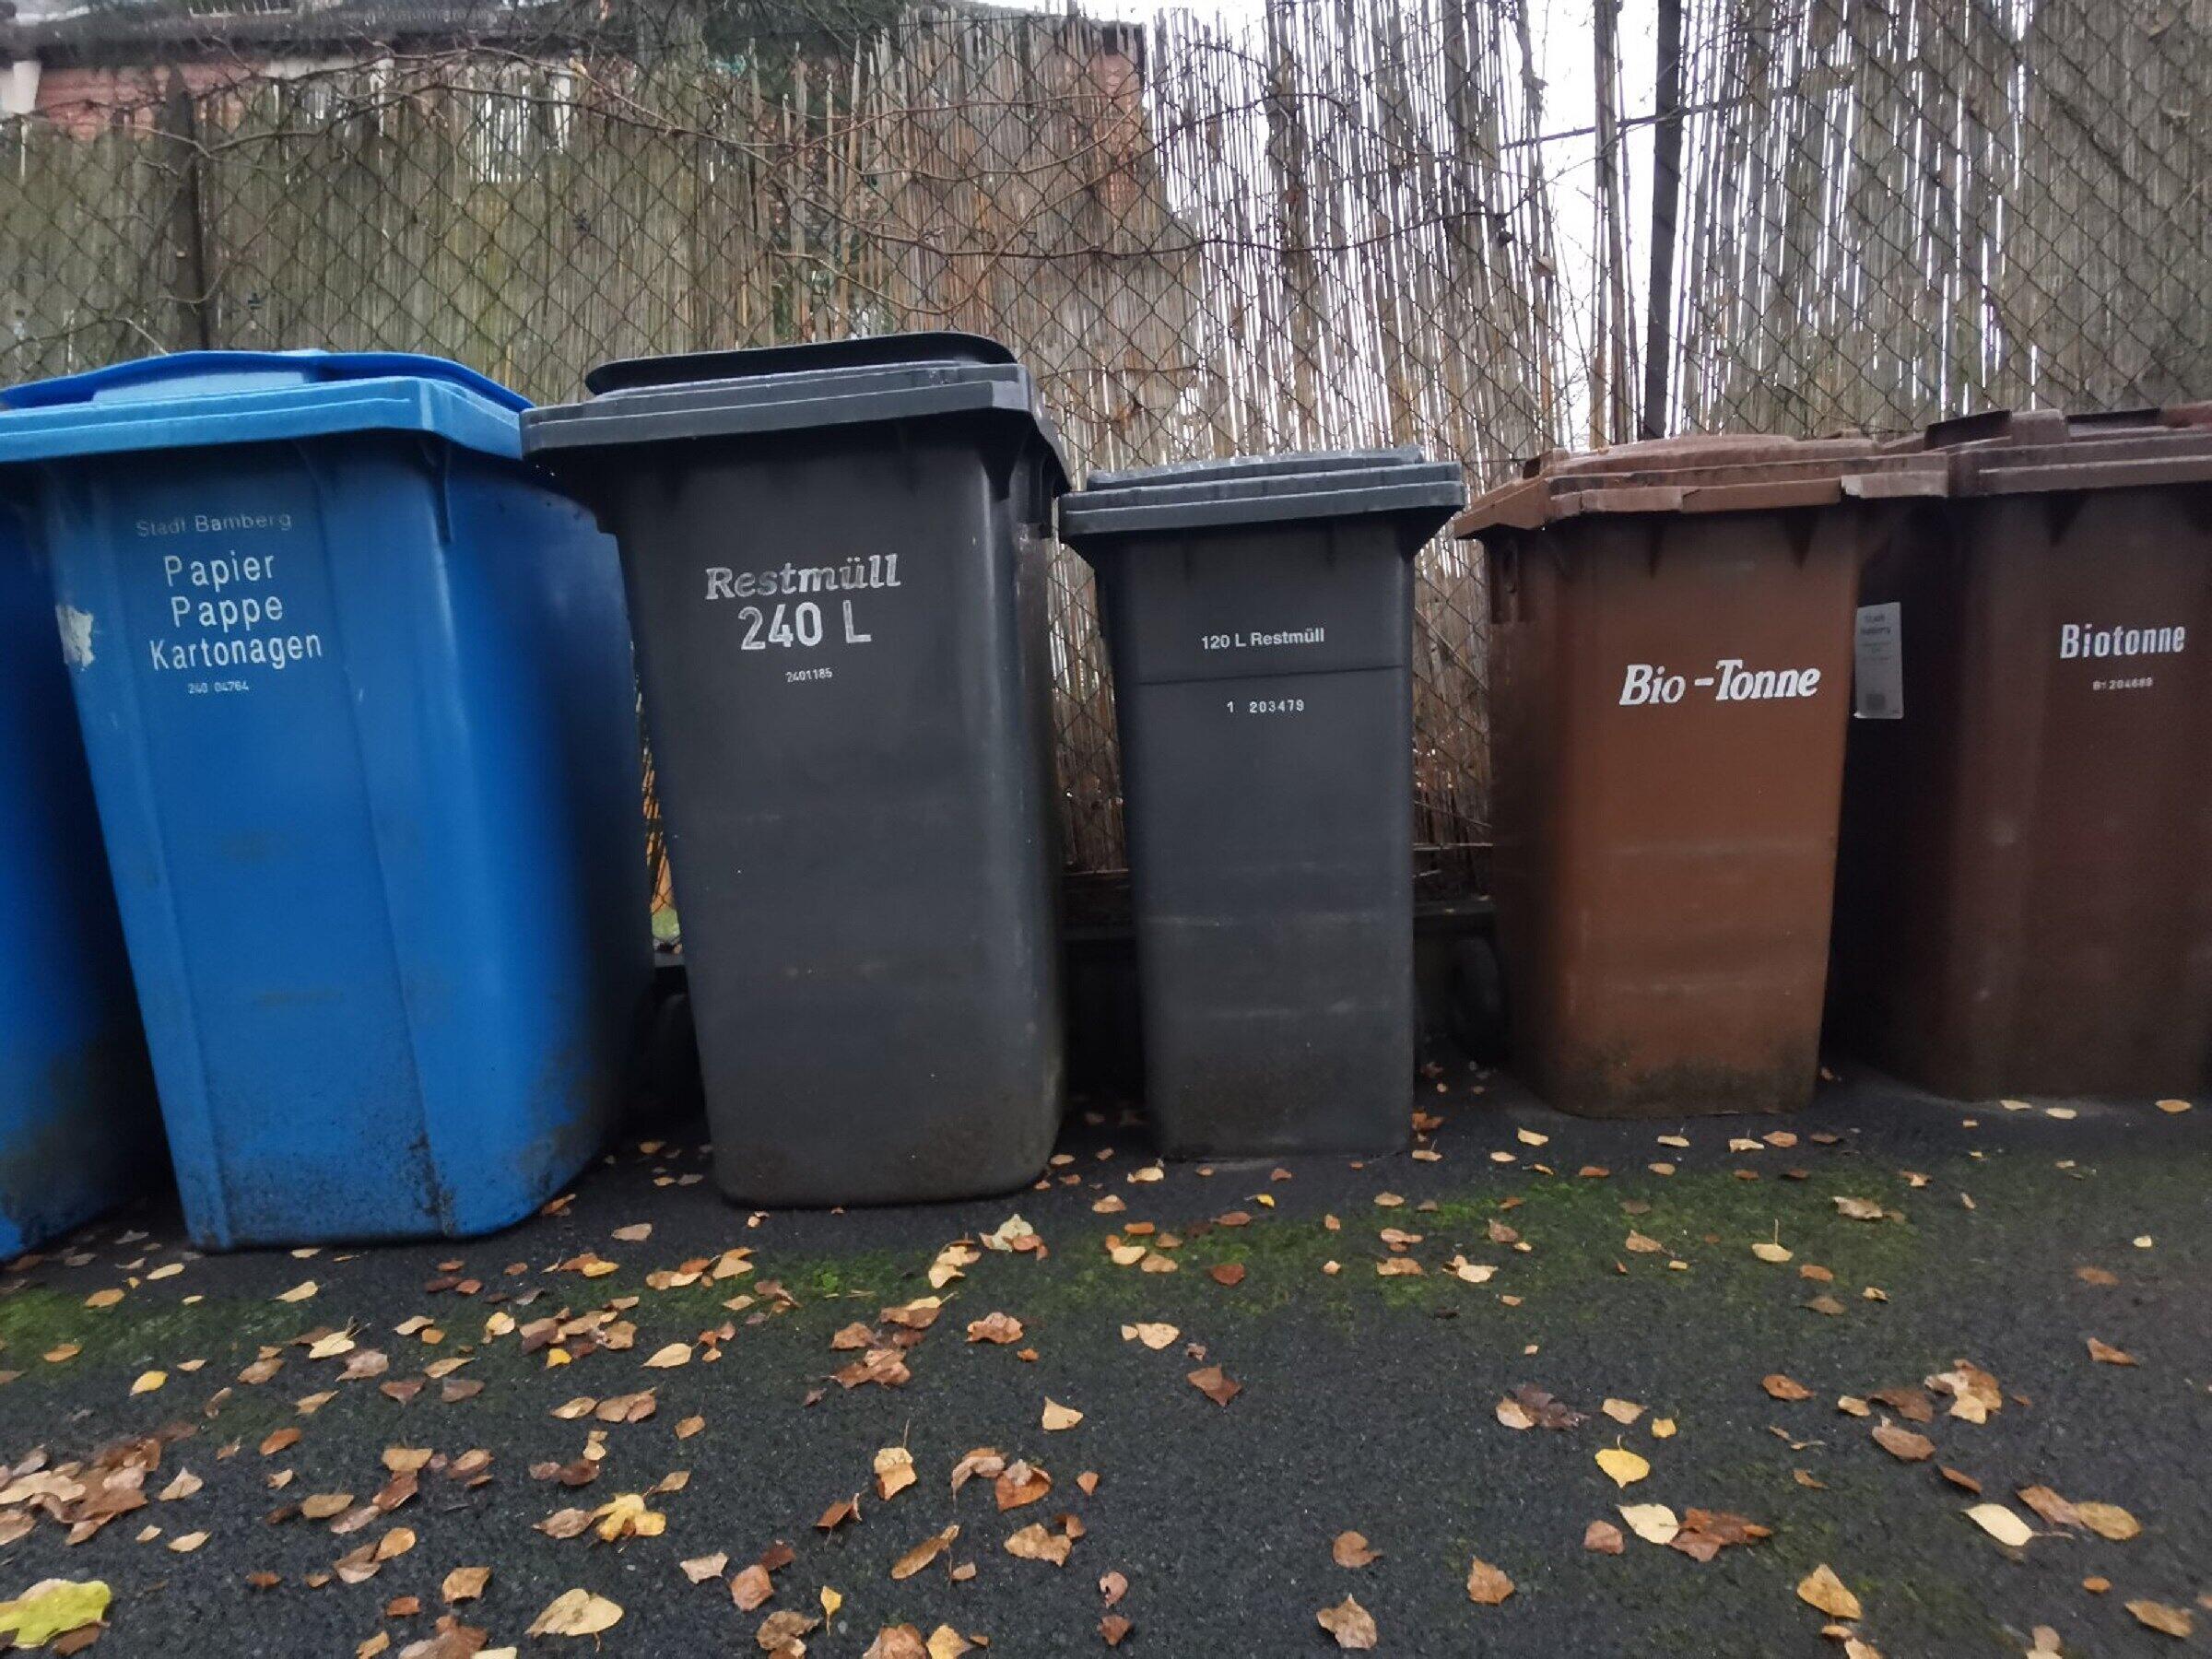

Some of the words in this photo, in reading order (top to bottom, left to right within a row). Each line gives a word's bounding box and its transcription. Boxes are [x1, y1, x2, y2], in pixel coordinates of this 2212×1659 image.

[195, 513, 292, 532] Bamberg
[163, 550, 274, 593] Papier
[705, 553, 901, 599] Restmüll
[171, 596, 283, 632] Pappe
[738, 602, 823, 650] 240
[842, 599, 872, 643] L
[149, 633, 322, 671] Kartonagen
[1202, 634, 1230, 650] 120
[1234, 632, 1247, 648] L
[1251, 627, 1324, 646] Restmüll
[2060, 623, 2185, 659] Biotonne
[1227, 700, 1234, 713] 1
[1249, 699, 1305, 713] 203479
